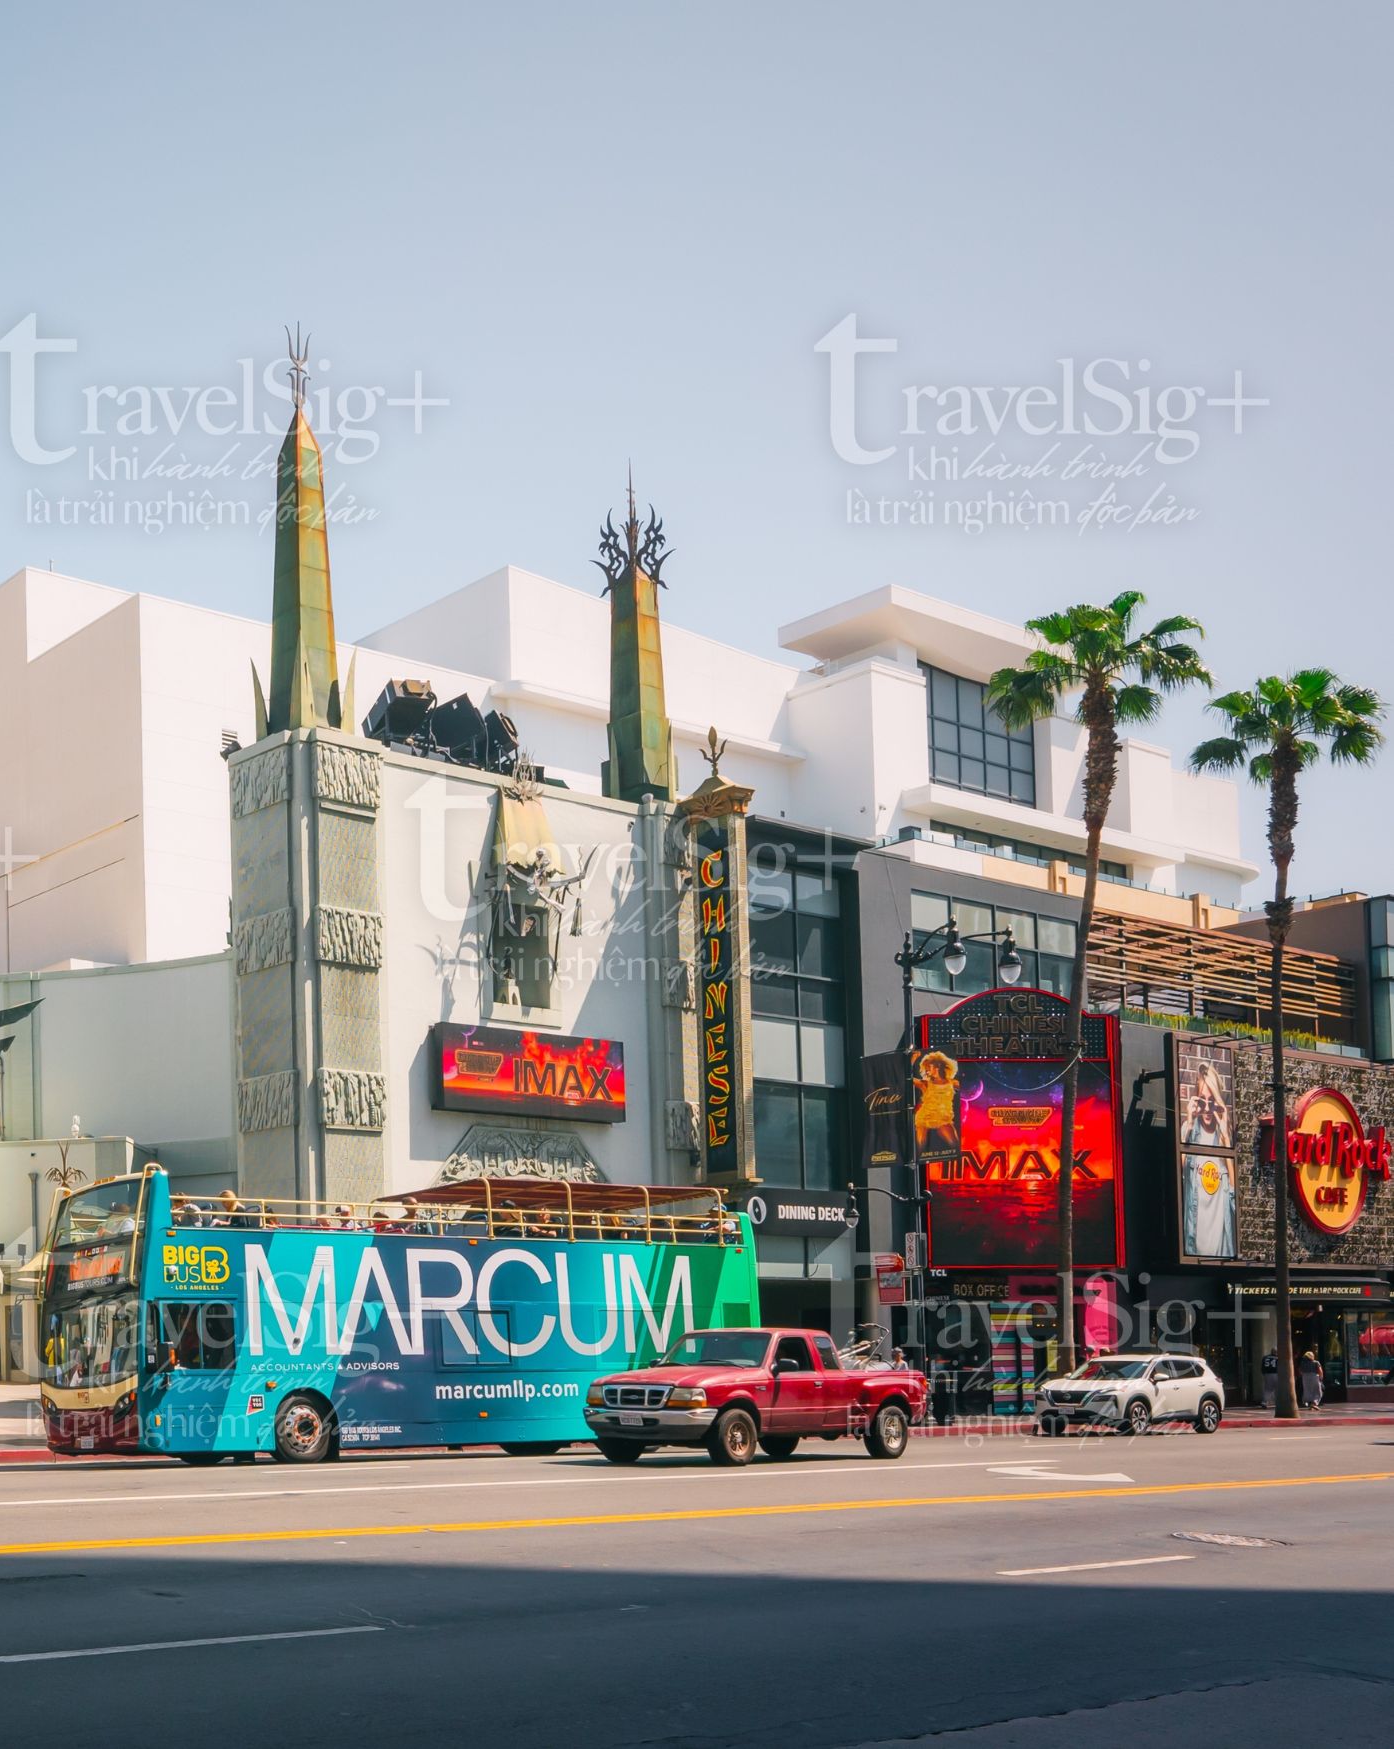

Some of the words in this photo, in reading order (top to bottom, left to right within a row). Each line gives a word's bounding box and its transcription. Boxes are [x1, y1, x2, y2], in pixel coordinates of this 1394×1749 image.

[701, 850, 730, 1147] CHINESE
[994, 995, 1043, 1013] TCL
[961, 1016, 1067, 1034] CHINES
[513, 1058, 613, 1101] IMAX
[1335, 1122, 1391, 1181] Rock
[941, 1149, 1099, 1181] IMAX
[1316, 1186, 1348, 1205] CAFE
[778, 1205, 816, 1220] DINING
[818, 1207, 846, 1222] DECK
[163, 1245, 200, 1265] BIG
[930, 1269, 947, 1277] TCL
[245, 1243, 695, 1357] MARCUM
[953, 1284, 973, 1295] BOX
[977, 1285, 1009, 1297] OFFCE
[251, 1363, 334, 1372] ACCOUNTANTS
[346, 1362, 400, 1371] ADVISORS
[435, 1380, 579, 1402] marcumllp.com
